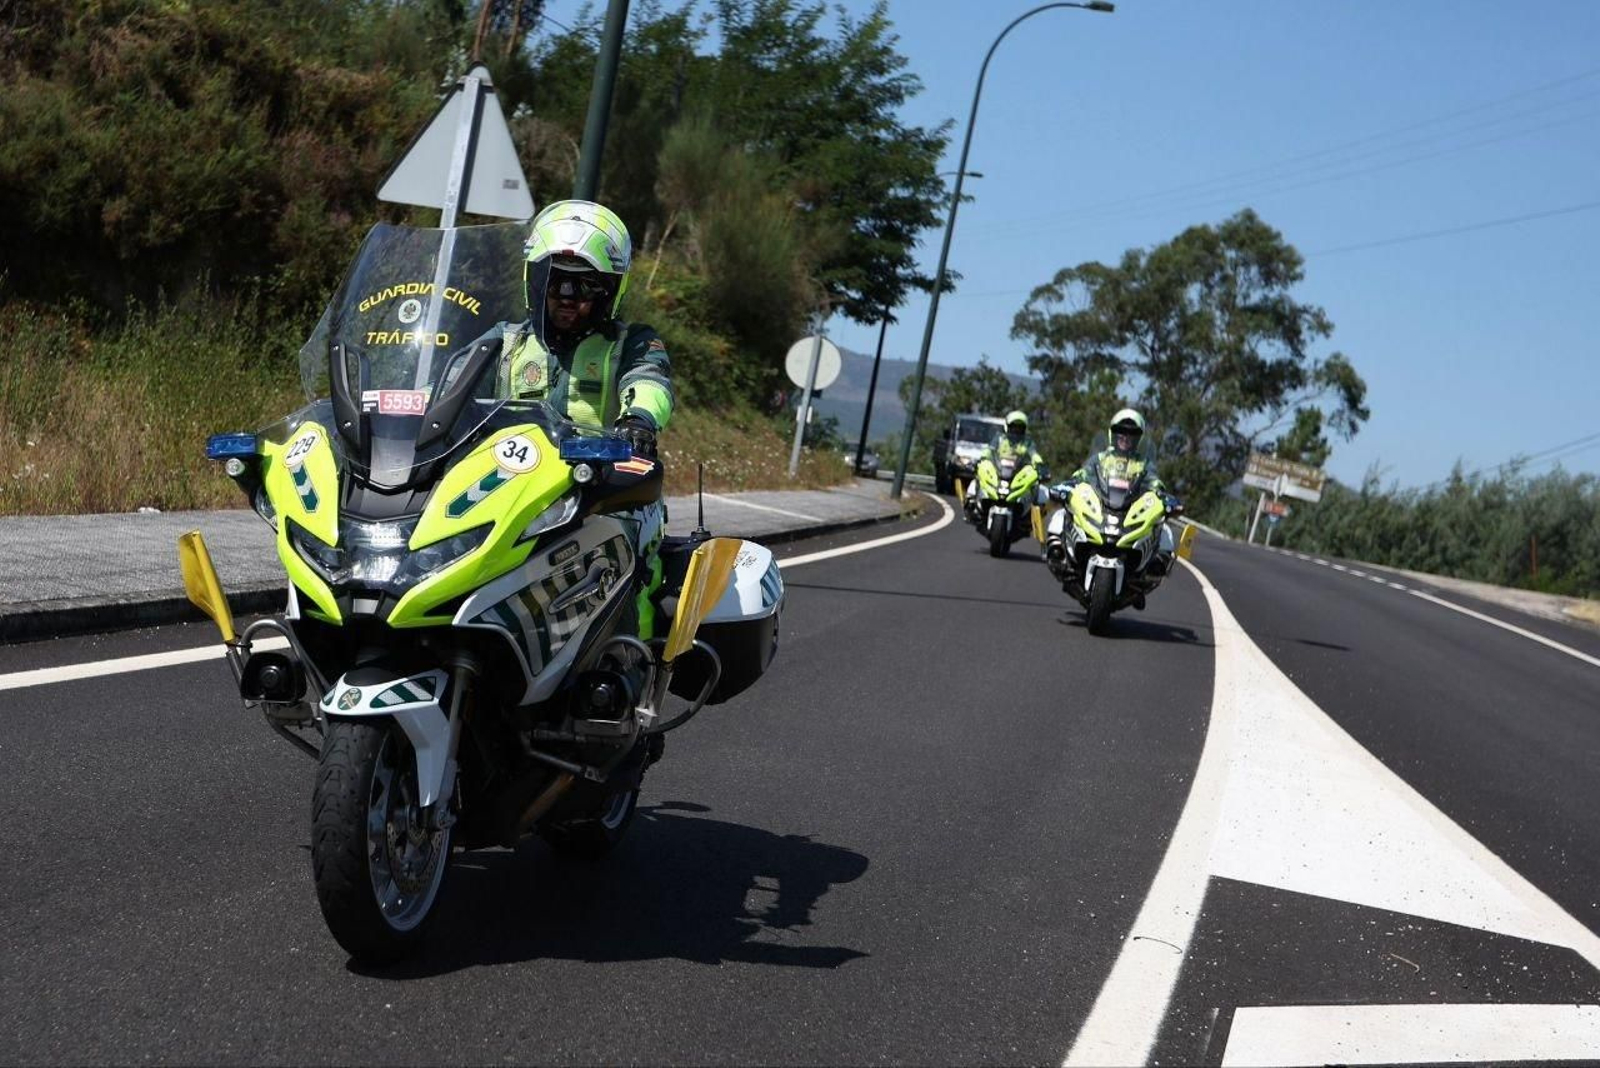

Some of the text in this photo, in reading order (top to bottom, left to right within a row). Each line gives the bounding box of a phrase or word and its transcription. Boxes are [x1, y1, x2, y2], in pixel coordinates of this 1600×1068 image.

[359, 282, 481, 315] GUARDIA CIVIL
[366, 328, 449, 346] TRÁFCO
[382, 393, 423, 411] 5593
[286, 436, 316, 459] 229
[503, 440, 528, 463] 34
